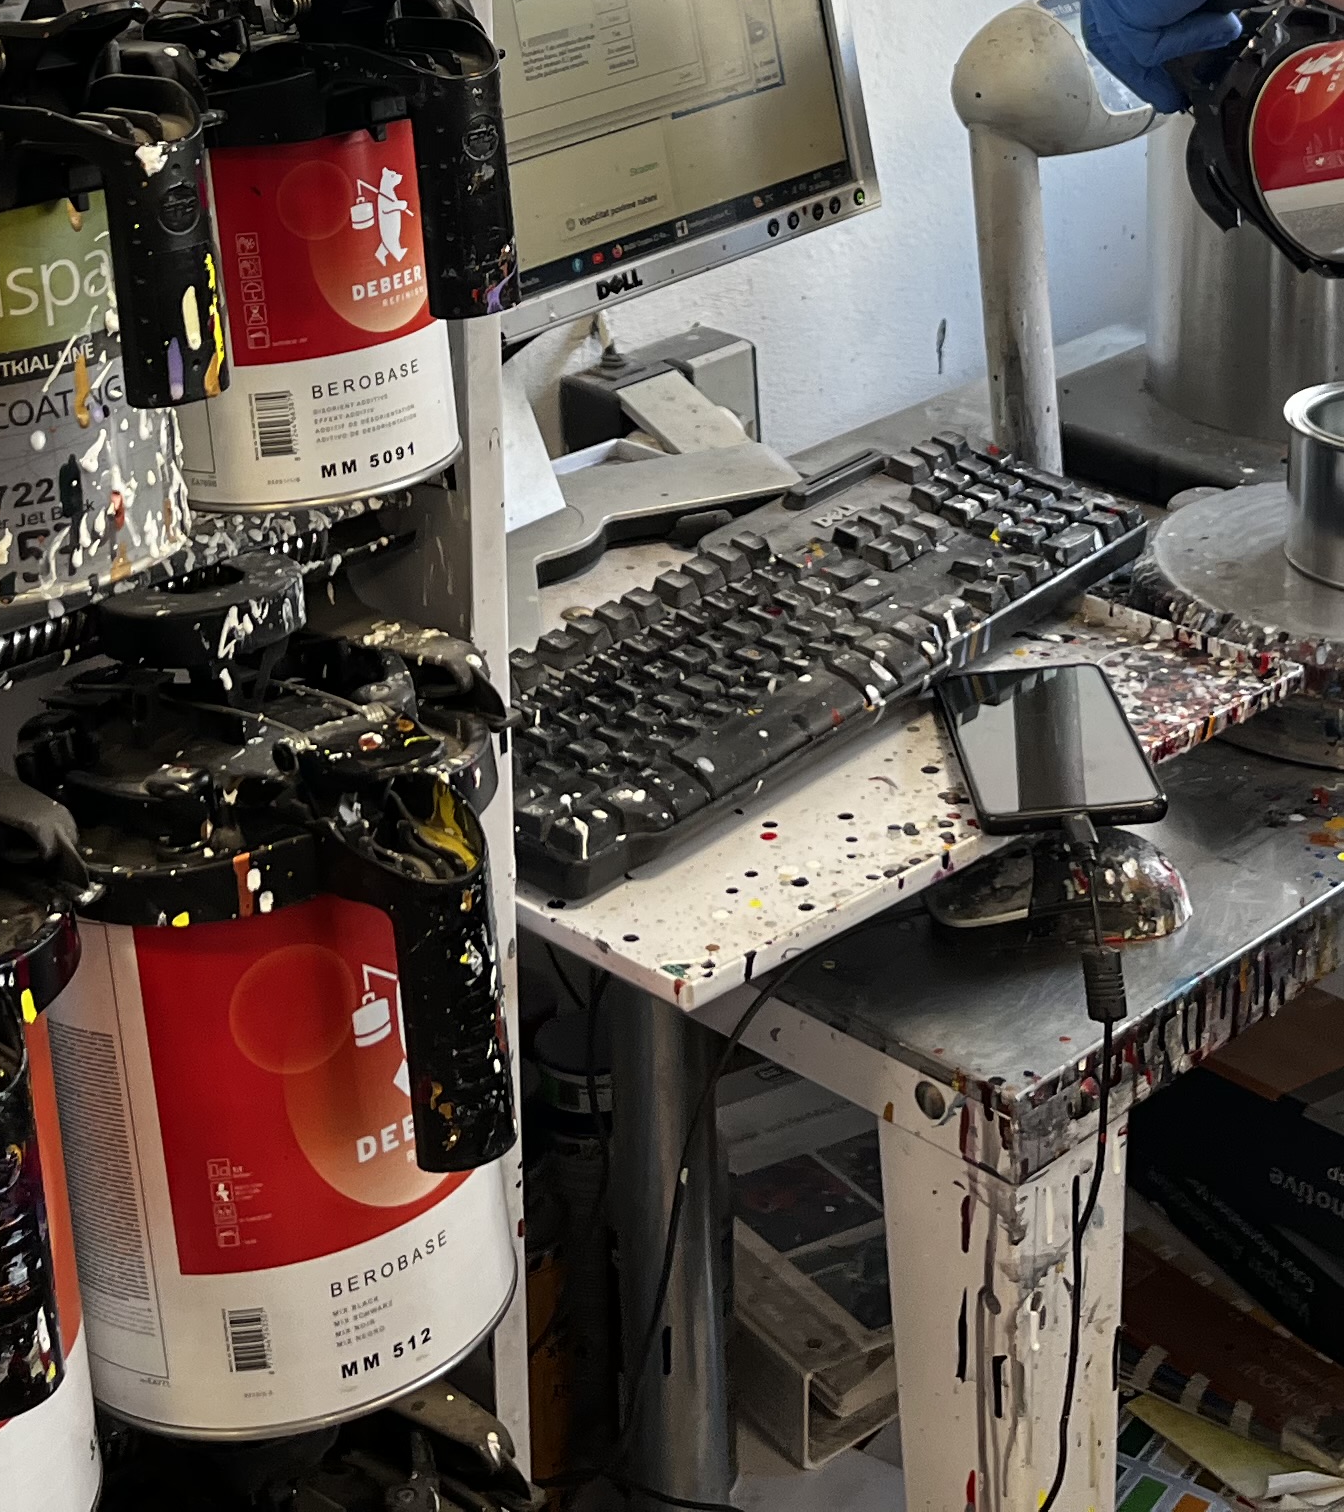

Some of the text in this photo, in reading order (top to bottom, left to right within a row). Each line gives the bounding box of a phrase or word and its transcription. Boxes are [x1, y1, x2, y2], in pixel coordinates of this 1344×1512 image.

[352, 265, 423, 301] DEBEER
[596, 268, 644, 301] DELL
[311, 359, 420, 400] BEROBASE
[321, 441, 416, 479] MM 5091
[16, 511, 46, 529] Jet
[329, 1229, 449, 1299] BEROBASE
[340, 1327, 433, 1380] MM 512
